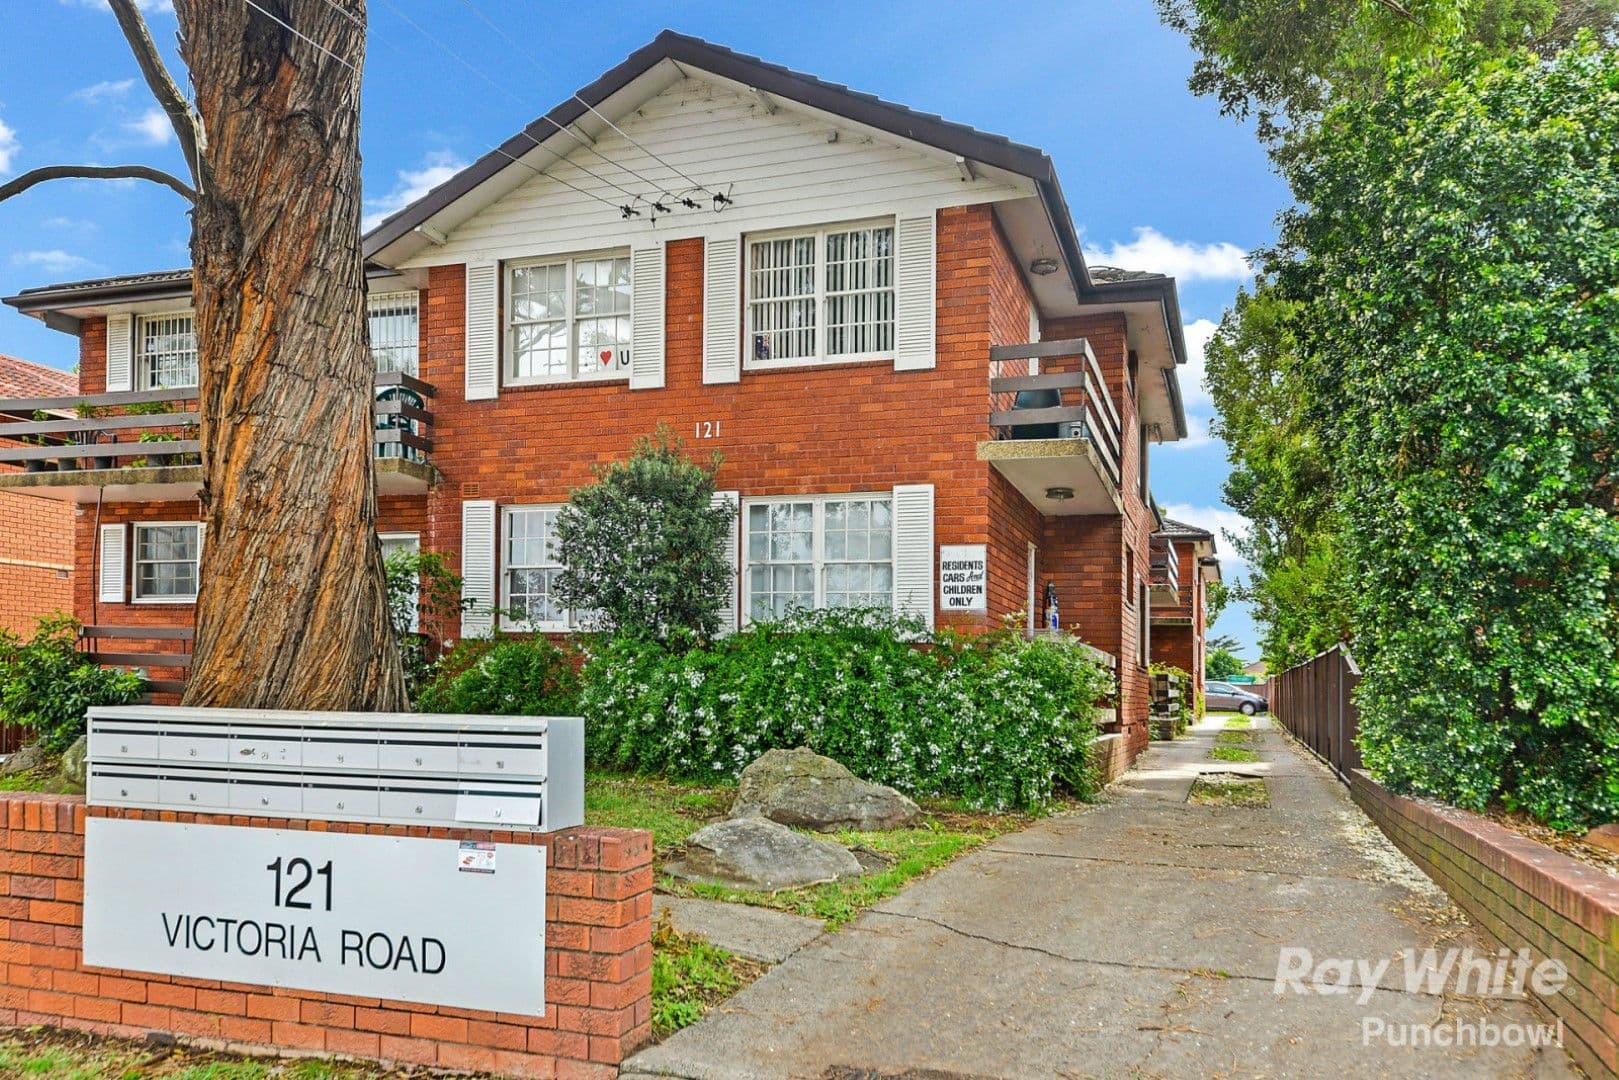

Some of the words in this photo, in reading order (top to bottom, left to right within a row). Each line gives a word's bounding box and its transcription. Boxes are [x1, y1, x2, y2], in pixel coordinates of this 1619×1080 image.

[620, 350, 630, 366] U
[695, 421, 720, 439] 121
[942, 560, 984, 570] RESIDENTS
[943, 573, 965, 582] CARS
[943, 585, 983, 594] CHILDREN
[949, 597, 973, 606] ONLY
[266, 856, 333, 911] 121
[161, 912, 322, 963] VICTORIA
[340, 929, 446, 975] ROAD
